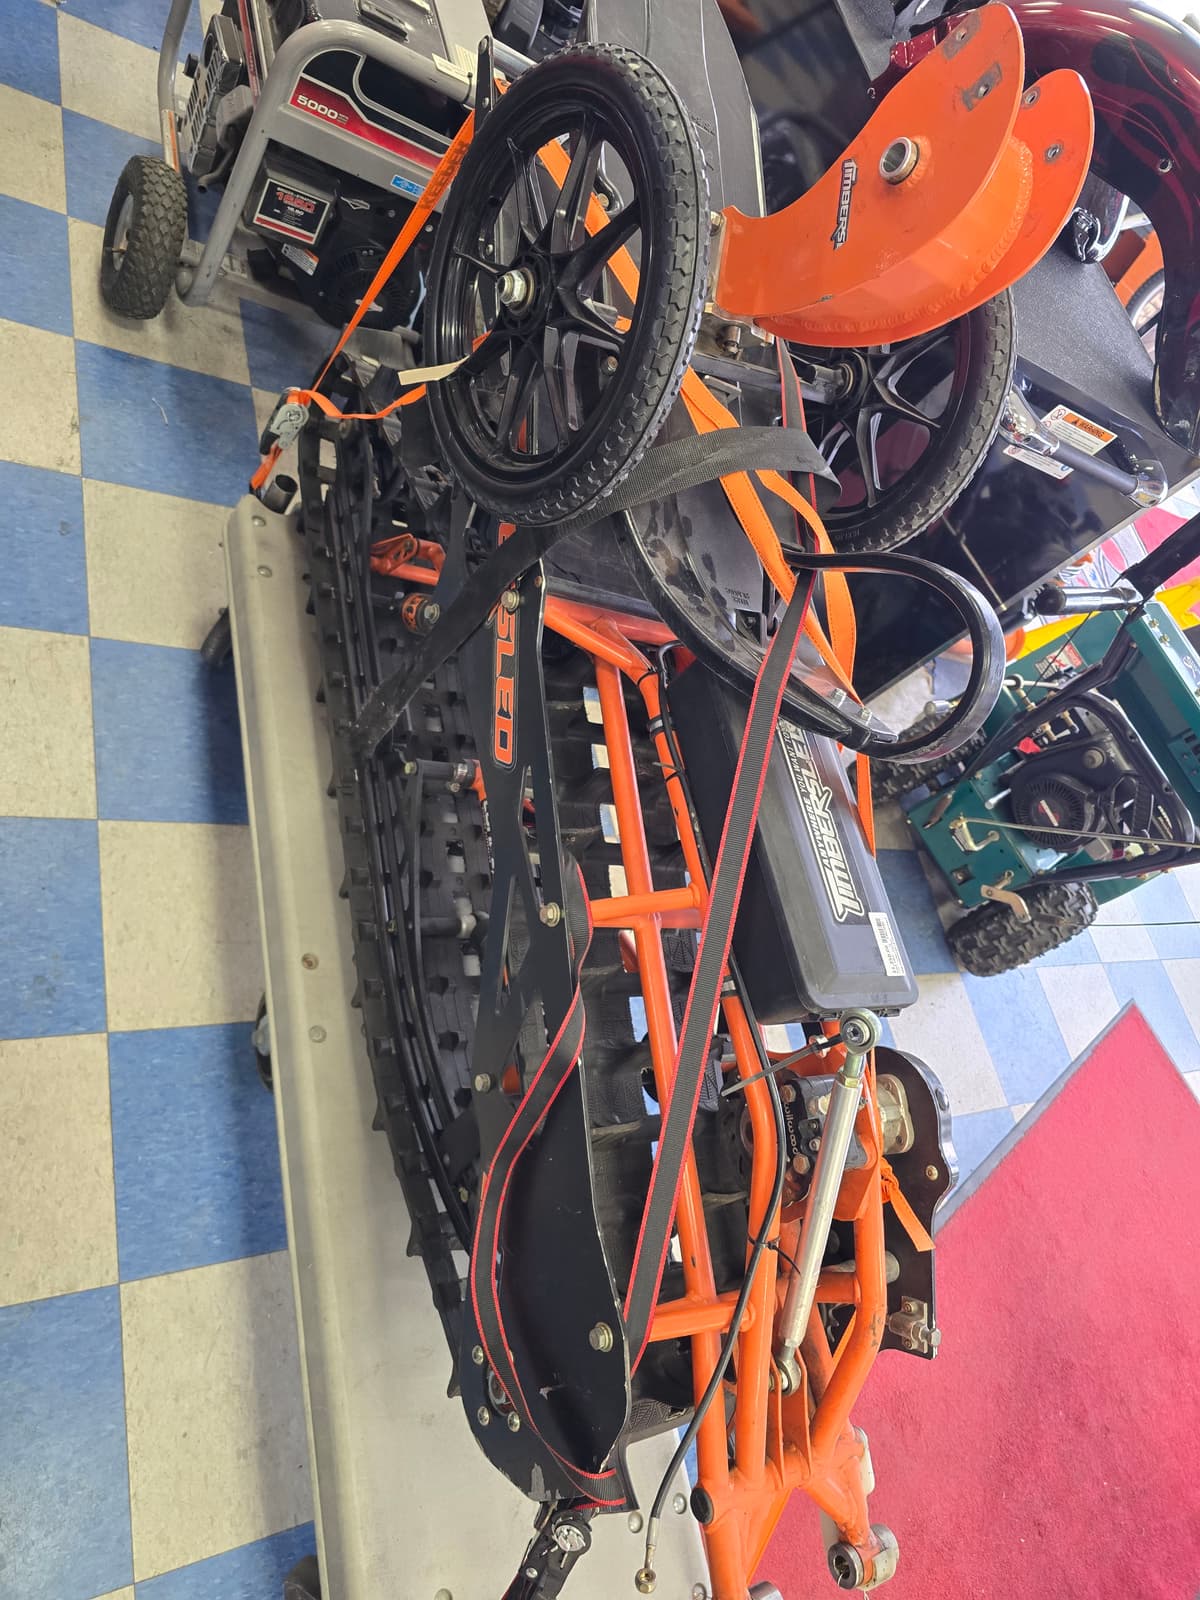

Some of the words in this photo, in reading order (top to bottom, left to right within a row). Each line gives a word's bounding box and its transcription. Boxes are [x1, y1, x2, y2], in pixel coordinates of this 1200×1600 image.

[296, 94, 338, 120] 5000
[786, 743, 801, 771] WANT
[796, 773, 808, 794] YOU
[803, 796, 831, 868] ANYWHERE
